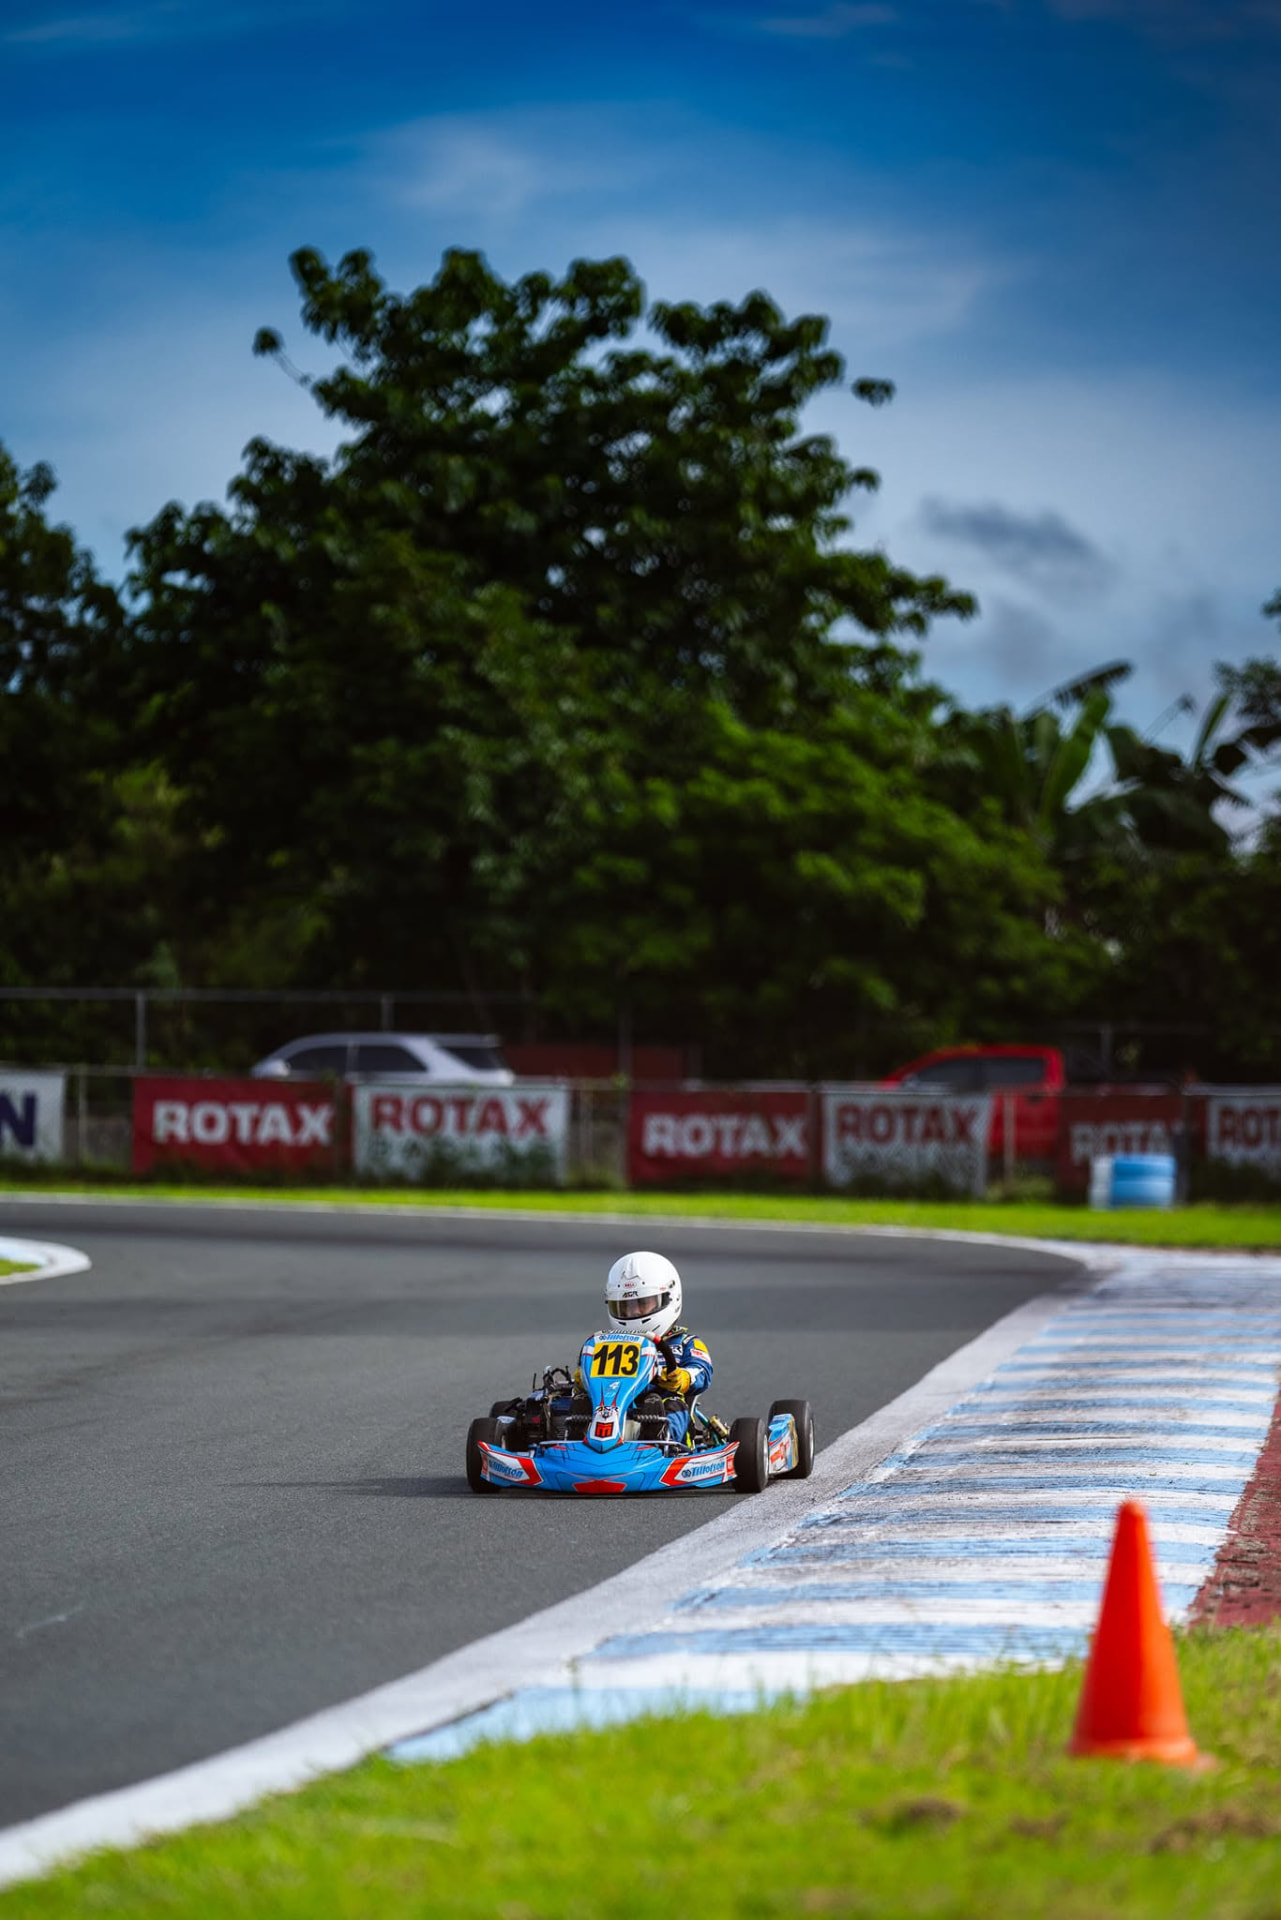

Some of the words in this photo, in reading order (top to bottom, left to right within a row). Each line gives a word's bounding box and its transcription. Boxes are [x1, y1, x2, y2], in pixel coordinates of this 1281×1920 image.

[153, 1101, 333, 1145] ROTAX
[370, 1094, 549, 1137] ROTAX
[642, 1114, 807, 1158] ROTAX
[836, 1104, 977, 1144] ROTAX
[593, 1345, 639, 1375] 113
[691, 1461, 726, 1477] Tillotson
